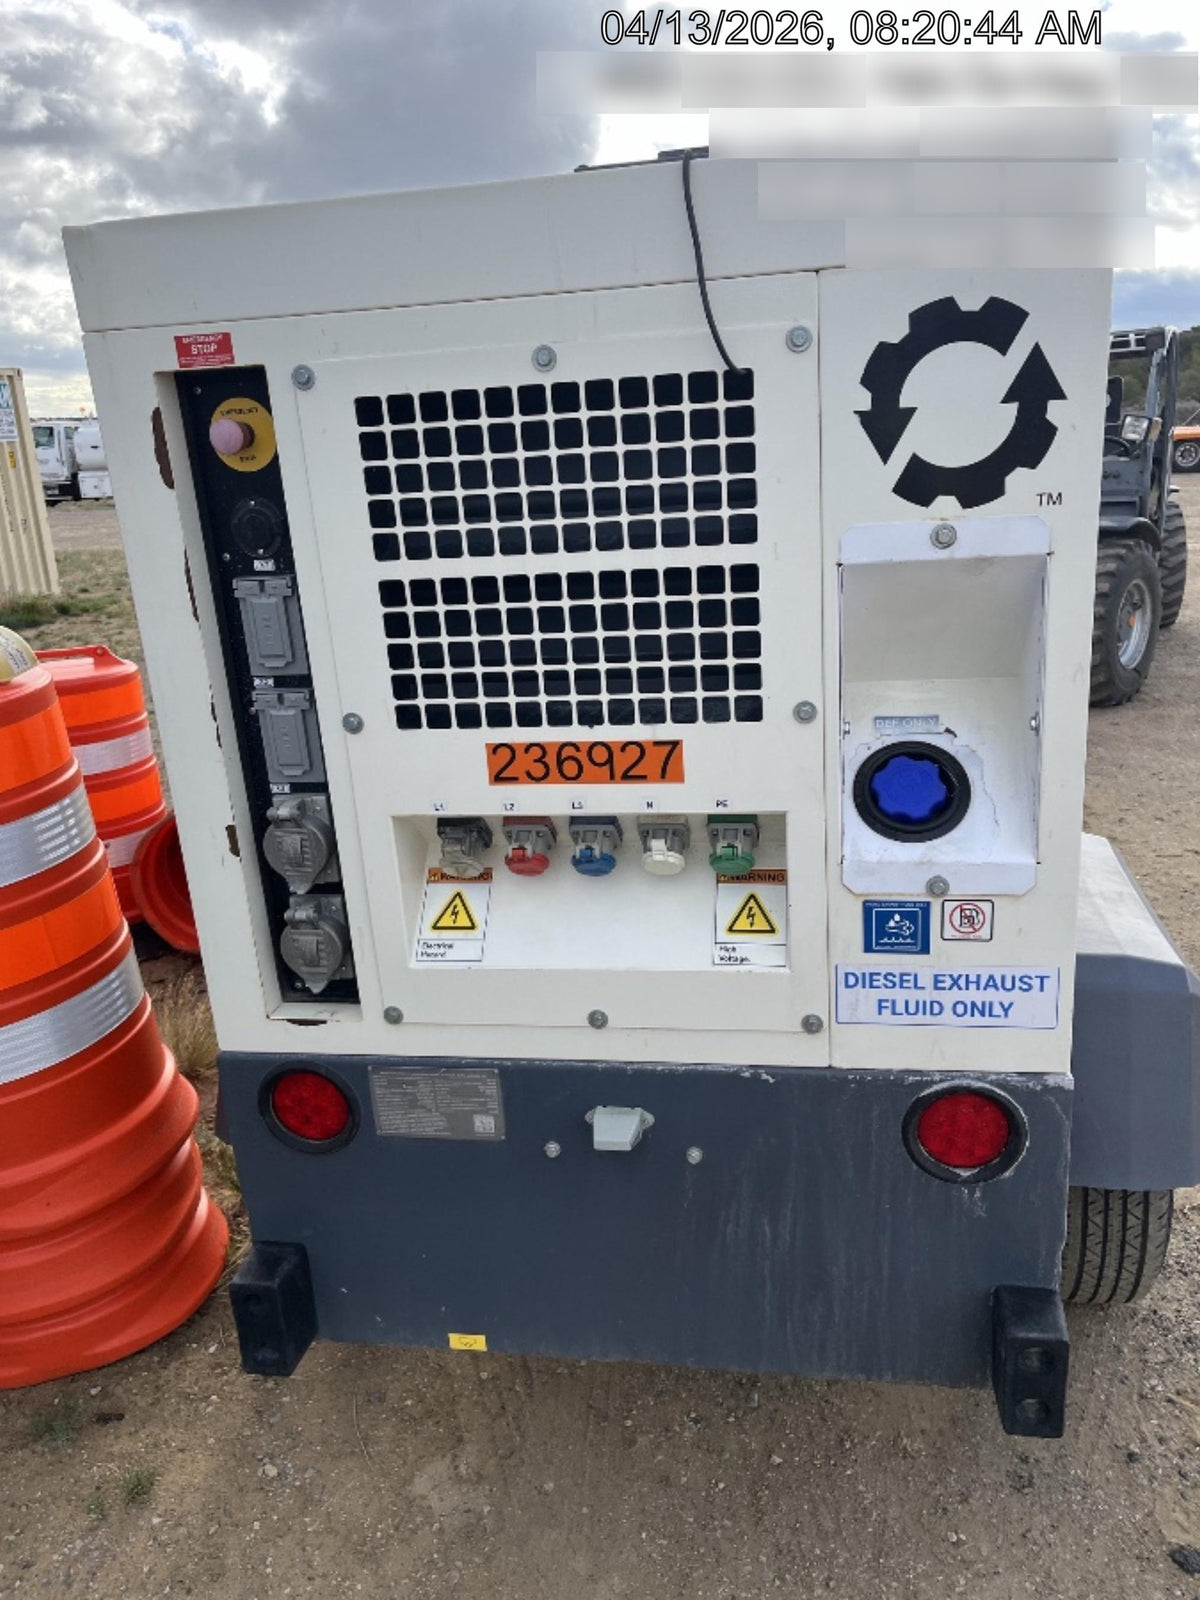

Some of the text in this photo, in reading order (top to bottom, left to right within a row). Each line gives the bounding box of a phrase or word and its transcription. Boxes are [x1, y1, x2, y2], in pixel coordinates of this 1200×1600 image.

[191, 343, 218, 355] STOP
[1036, 492, 1062, 506] TM
[491, 740, 681, 783] 236927
[504, 802, 515, 811] L2
[844, 971, 1051, 993] DIESEL EXHAUST
[877, 999, 1014, 1019] FLUID ONLY
